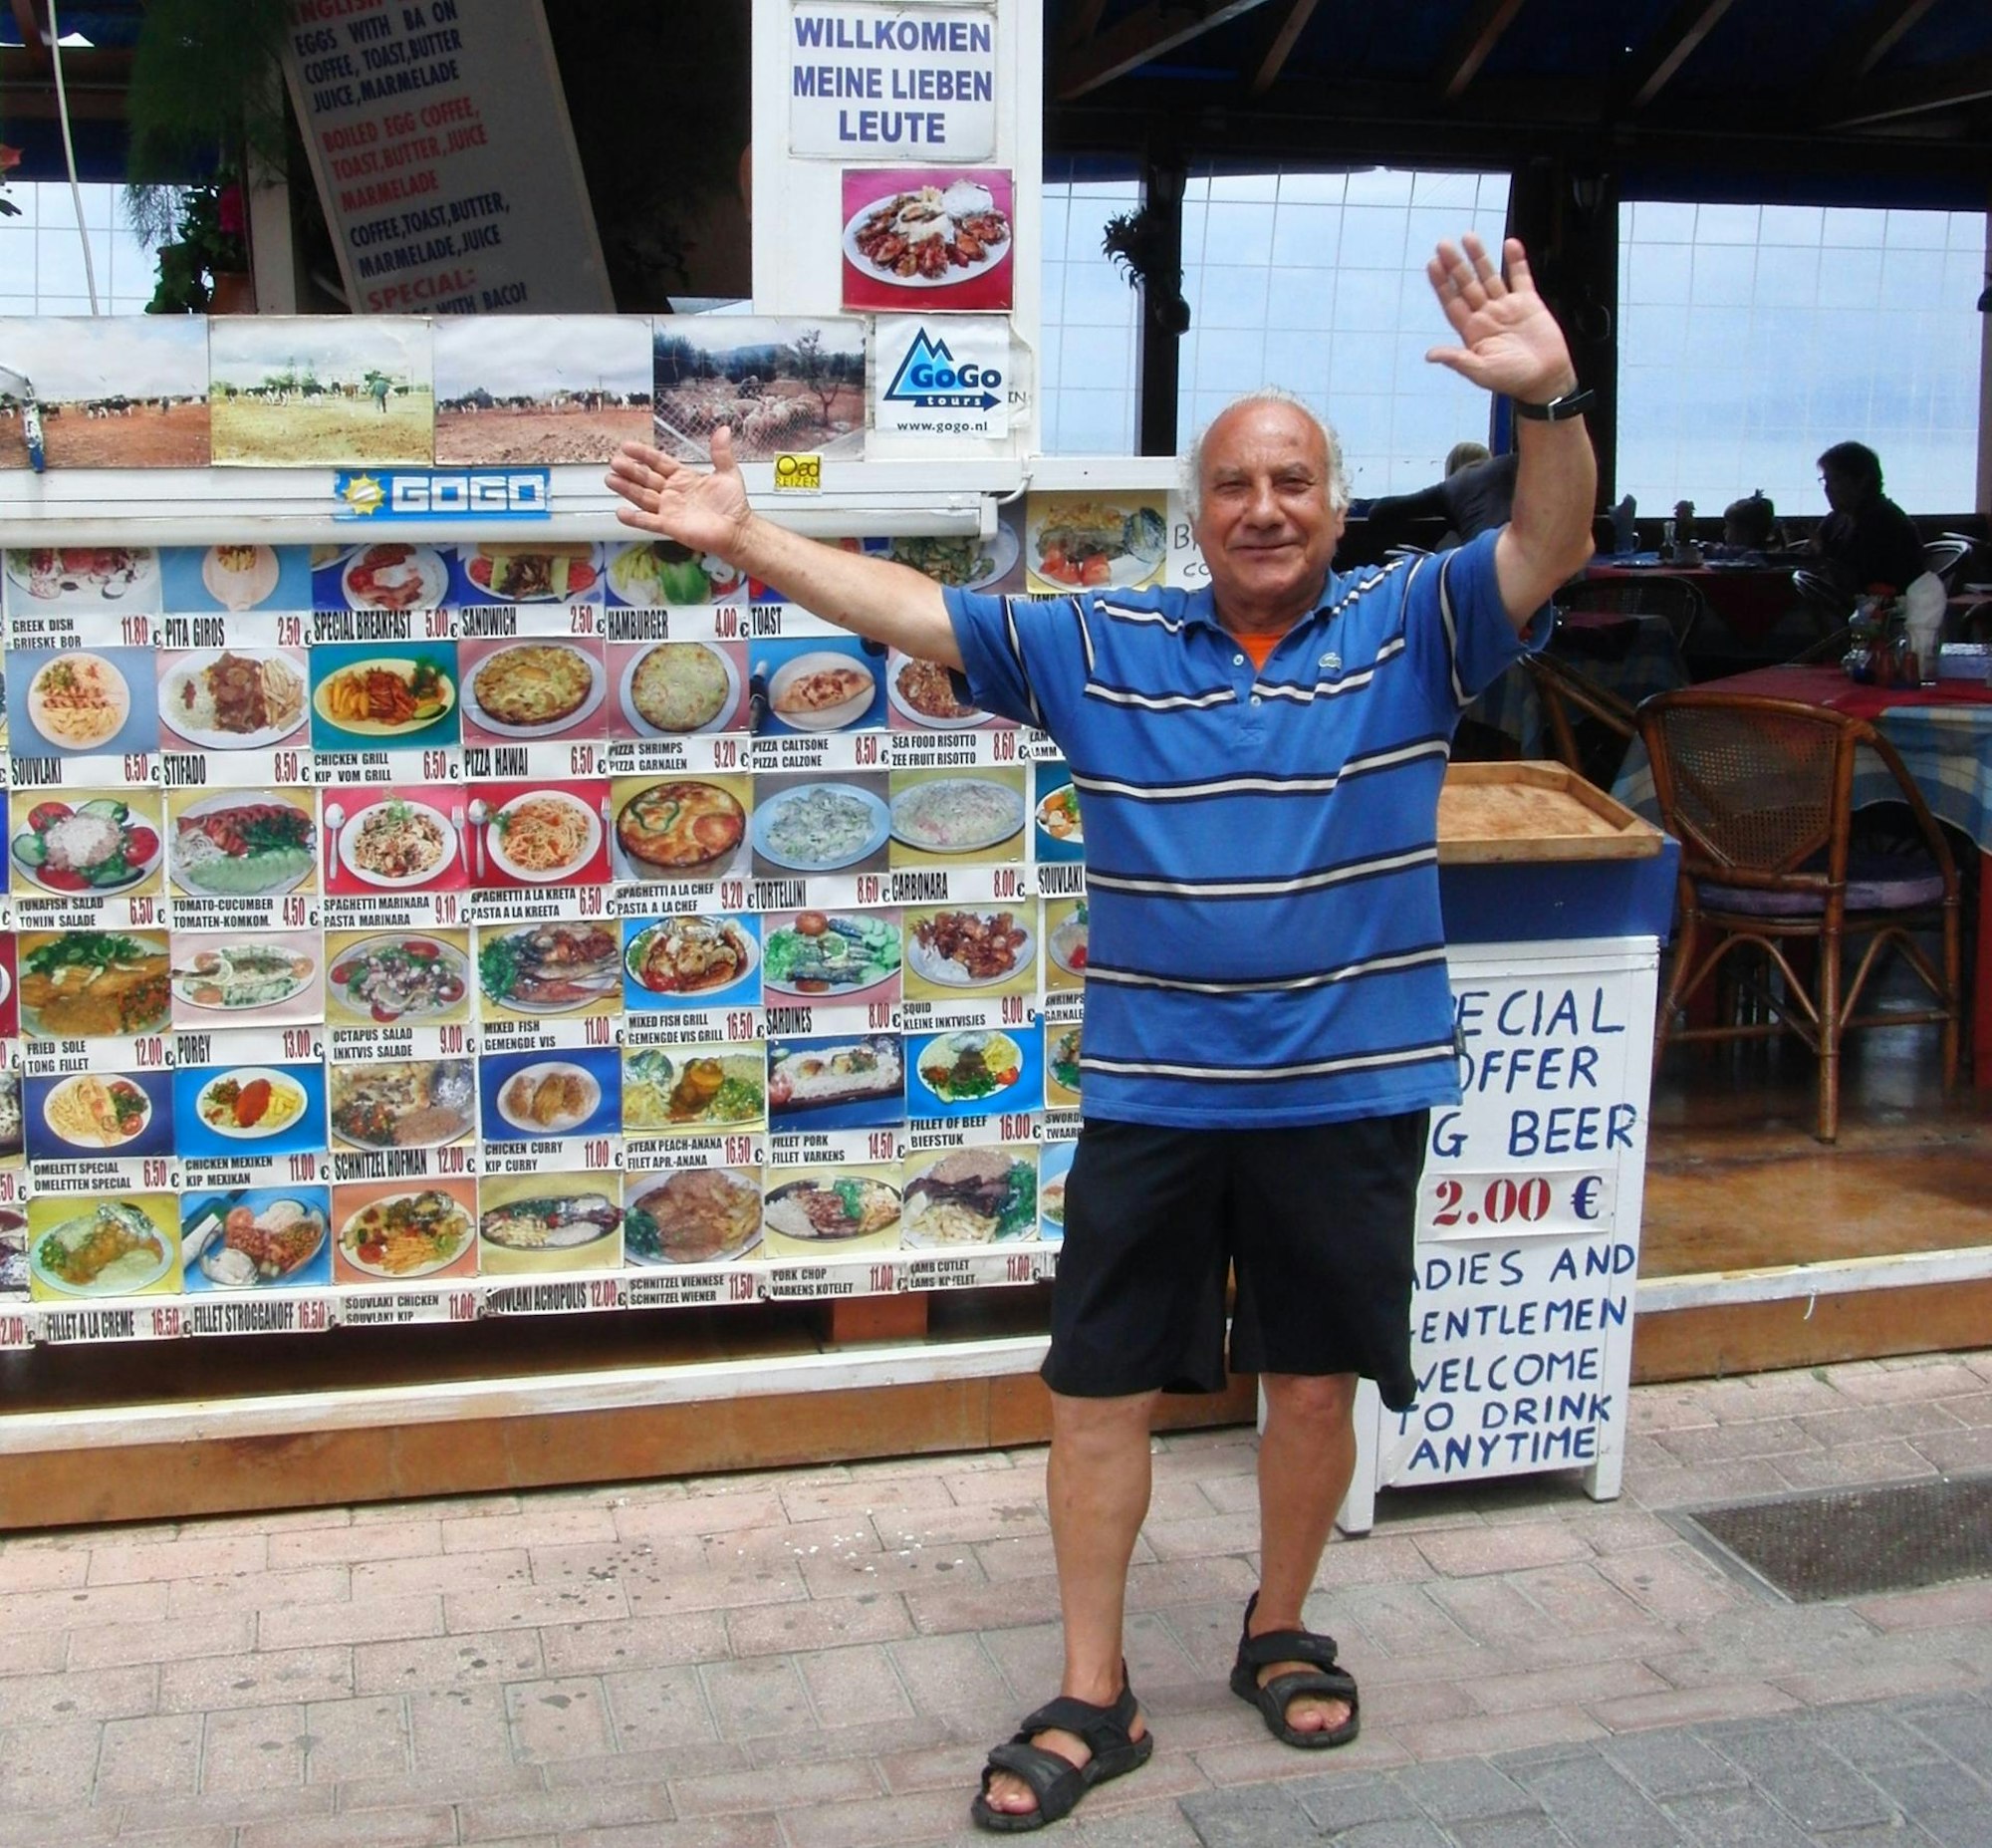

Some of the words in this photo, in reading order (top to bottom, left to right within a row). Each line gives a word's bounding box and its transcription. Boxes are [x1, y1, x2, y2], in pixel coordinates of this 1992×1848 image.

[294, 29, 337, 57] EGGS
[350, 16, 391, 44] WITH
[795, 17, 991, 53] WILLKOMEN
[794, 66, 882, 99] MEINE
[892, 69, 992, 102] LIEBEN
[321, 122, 377, 152] BOILED
[383, 113, 416, 137] EGG
[839, 111, 945, 143] LEUTE
[341, 170, 438, 212] MARMELADE
[910, 364, 1002, 391] GoGo
[927, 396, 982, 407] tours
[897, 419, 988, 434] www.gogo.nl
[777, 455, 820, 477] Oad
[776, 476, 820, 487] REIZEN
[12, 620, 44, 633] GREEK
[50, 618, 74, 632] DISH
[122, 617, 147, 646] 11.80
[166, 619, 188, 648] PITA
[193, 618, 225, 648] GIROS
[278, 616, 300, 646] 2.50
[315, 610, 355, 640] SPECIAL
[357, 610, 412, 640] BREAKFAST
[426, 610, 448, 638] 5.00
[462, 608, 517, 637] SANDWICH
[571, 606, 592, 634] 2.50
[608, 610, 668, 640] HAMBURGER
[715, 608, 736, 638] 4.00
[751, 607, 781, 636] TOAST
[465, 749, 491, 776] PIZZA
[496, 747, 528, 775] HAWAI
[572, 746, 593, 774] 6.50
[715, 741, 735, 768] 9.20
[753, 741, 778, 752] PIZZA
[782, 738, 829, 751] CALTSONE
[856, 736, 876, 764] 8.50
[892, 736, 908, 748] SEA
[912, 735, 935, 747] FOOD
[938, 734, 976, 747] RISOTTO
[994, 732, 1014, 761] 8.60
[892, 753, 906, 765] ZEE
[909, 753, 935, 765] FRUIT
[938, 751, 976, 764] RISOTTO
[12, 757, 62, 785] SOUVLAKI
[124, 753, 147, 781] 6.50
[164, 755, 205, 785] STIFADO
[275, 752, 298, 782] 8.50
[315, 754, 358, 766] CHICKEN
[363, 753, 389, 764] GRILL
[423, 750, 446, 779] 6.50
[315, 771, 331, 782] KIP
[339, 770, 361, 782] VOM
[366, 769, 391, 781] GRILL
[753, 758, 778, 769] PIZZA
[782, 755, 822, 767] CALZONE
[755, 880, 806, 910] TORTELLINI
[858, 876, 878, 903] 8.60
[892, 873, 948, 901] CARBONARA
[994, 870, 1015, 897] 8.00
[1039, 865, 1083, 894] SOUVLAKI
[325, 897, 376, 911] SPAGHETTI
[378, 897, 429, 909] MARINARA
[436, 895, 456, 924] 9.10
[580, 887, 601, 916] 6.50
[722, 882, 742, 910] 9.20
[129, 898, 152, 924] 6.50
[173, 899, 273, 912] TOMATO-CUCUMBER
[283, 898, 305, 926] 4.50
[325, 915, 355, 927] PASTA
[360, 914, 410, 926] MARINARA
[767, 1007, 812, 1035] SARDINES
[869, 1003, 889, 1029] 8.00
[903, 1002, 931, 1014] SQUID
[1002, 996, 1022, 1024] 9.00
[903, 1017, 933, 1030] KLEINE
[935, 1014, 985, 1029] INKTVISJES
[1454, 987, 1624, 1036] ECIAL
[333, 1029, 377, 1043] OCTAPUS
[382, 1027, 412, 1040] SALAD
[440, 1025, 462, 1054] 9.00
[485, 1022, 514, 1034] MIXED
[519, 1020, 540, 1032] FISH
[585, 1016, 609, 1044] 11.00
[726, 1012, 753, 1040] 16.50
[27, 1042, 55, 1055] FRIED
[63, 1040, 86, 1053] SOLE
[134, 1038, 161, 1067] 12.00
[177, 1035, 211, 1064] PORGY
[283, 1030, 311, 1058] 13.00
[334, 1046, 373, 1060] INKTVIS
[377, 1044, 412, 1057] SALADE
[485, 1037, 536, 1050] GEMENGDE
[540, 1036, 556, 1048] VIS
[29, 1059, 54, 1072] TONG
[60, 1058, 89, 1071] FILLET
[911, 1119, 943, 1132] FILLET
[946, 1119, 960, 1130] OF
[963, 1115, 987, 1129] BEEF
[1000, 1114, 1030, 1141] 16.00
[911, 1134, 963, 1148] BIEFSTUK
[1432, 1112, 1468, 1158] G
[1508, 1103, 1636, 1158] BEER
[486, 1143, 527, 1156] CHICKEN
[531, 1142, 563, 1154] CURRY
[586, 1141, 609, 1169] 11.00
[725, 1137, 749, 1164] 16.50
[773, 1136, 799, 1148] FILLET
[804, 1136, 828, 1147] PORK
[869, 1133, 893, 1159] 14.50
[773, 1152, 799, 1164] FILLET
[804, 1150, 845, 1162] VARKENS
[34, 1163, 77, 1175] OMELETT
[80, 1162, 119, 1174] SPECIAL
[143, 1160, 166, 1188] 6.50
[335, 1151, 385, 1180] SCHNITZEL
[388, 1149, 426, 1178] HOFMAN
[437, 1147, 463, 1174] 12.00
[486, 1160, 501, 1173] KIP
[506, 1160, 538, 1172] CURRY
[34, 1179, 89, 1191] OMELETTEN
[92, 1178, 130, 1189] SPECIAL
[1432, 1177, 1551, 1226] 2.00
[1570, 1176, 1603, 1219] €
[773, 1269, 798, 1280] PORK
[802, 1268, 827, 1280] CHOP
[1549, 1244, 1634, 1282] AND
[772, 1285, 814, 1296] VARKENS
[816, 1283, 853, 1295] KOTELET
[194, 1304, 222, 1333] FILLET
[298, 1301, 325, 1328] 16.50
[1410, 1296, 1626, 1343] ENTLEMEN
[1399, 1402, 1453, 1436] TO
[1482, 1392, 1612, 1429] DRINK
[1408, 1427, 1596, 1473] ANYTIME
